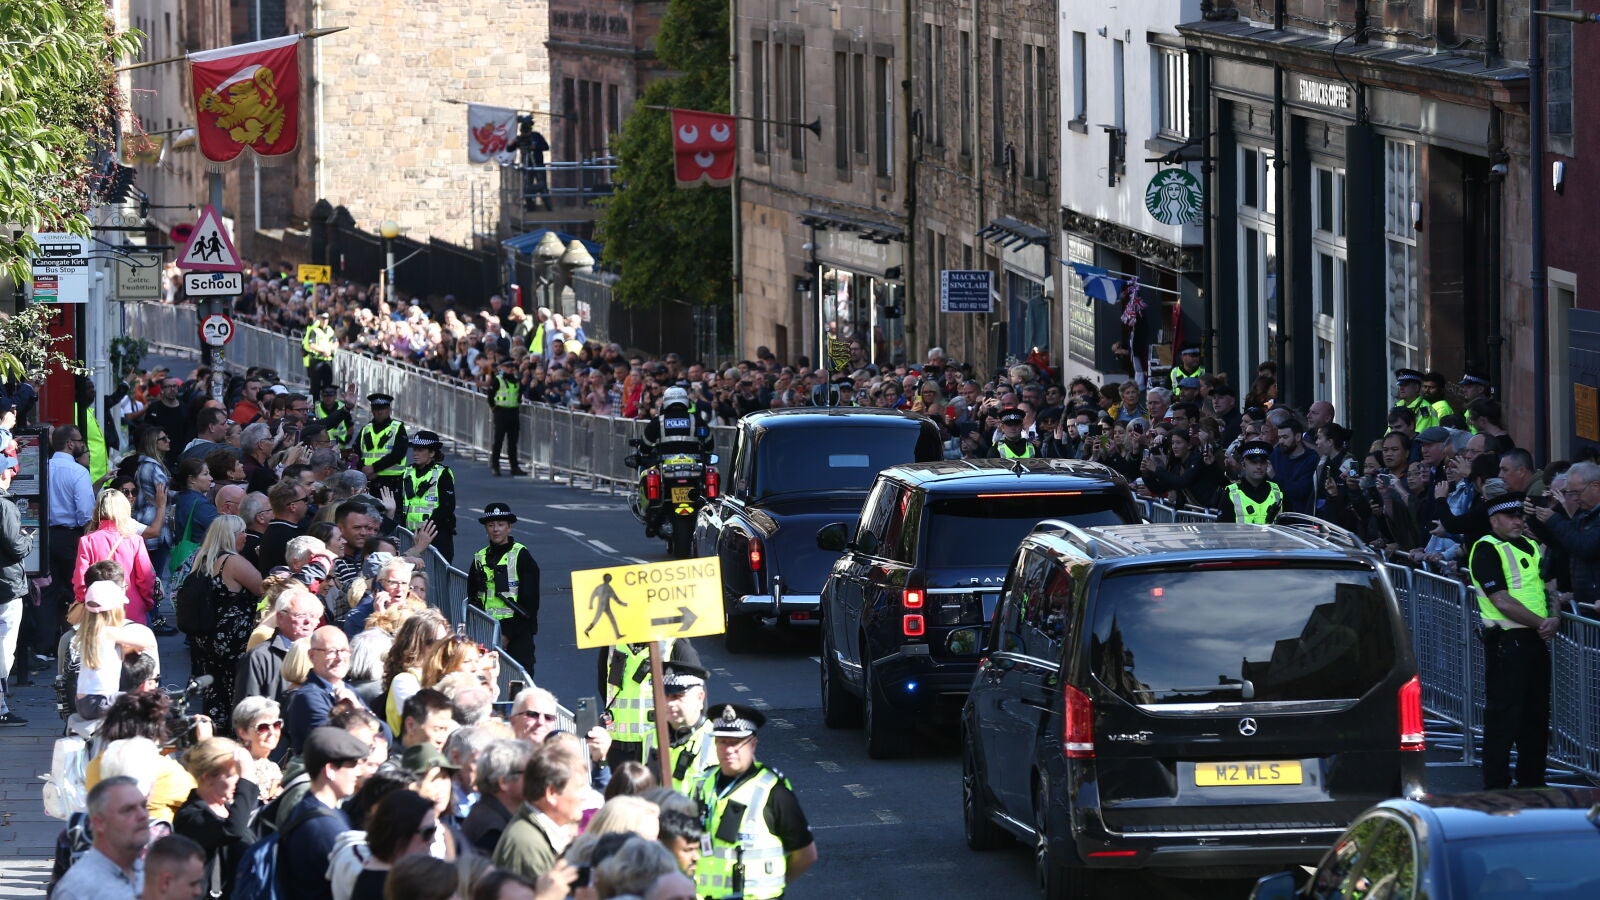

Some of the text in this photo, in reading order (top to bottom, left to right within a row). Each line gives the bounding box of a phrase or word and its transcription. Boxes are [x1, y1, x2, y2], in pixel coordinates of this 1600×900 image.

[1299, 79, 1347, 108] STARBUCKS COFFEE
[35, 259, 70, 267] Canongate
[59, 266, 76, 274] Stop
[191, 278, 237, 290] School
[624, 563, 715, 586] CROSSING
[647, 584, 696, 603] POINT
[1216, 764, 1281, 780] M2 WLS
